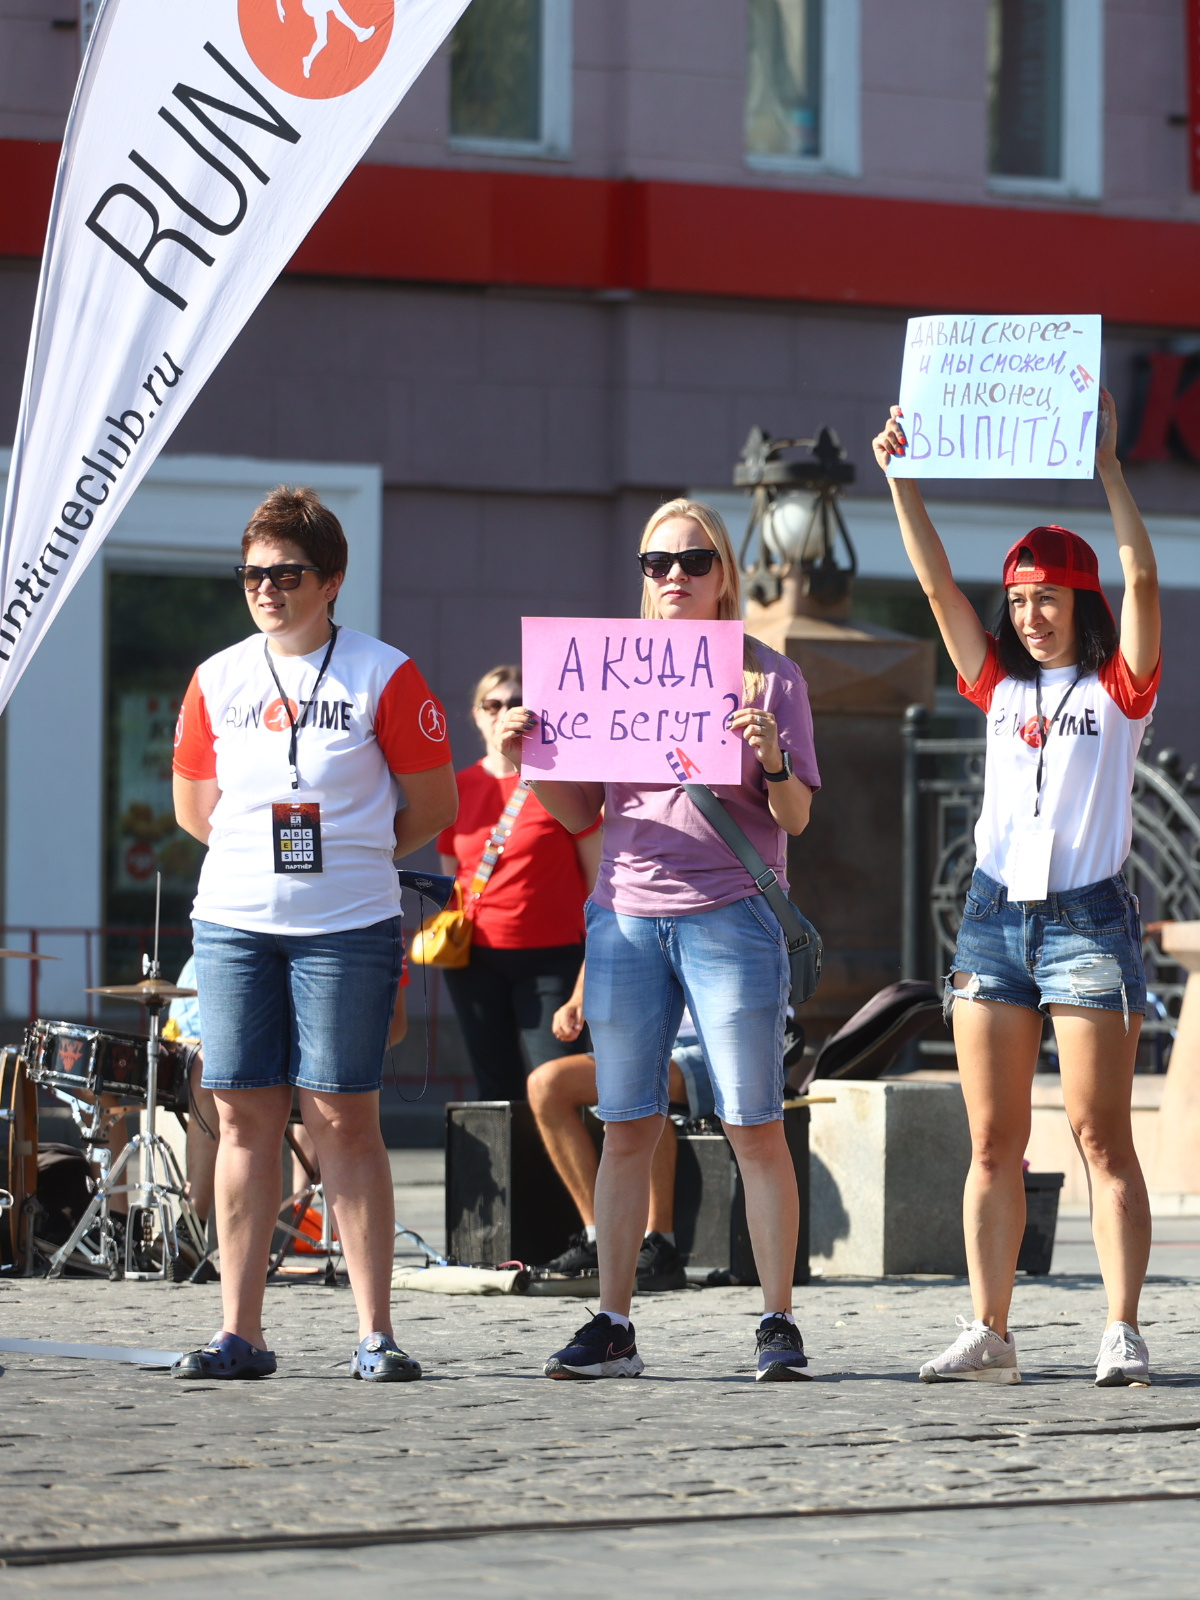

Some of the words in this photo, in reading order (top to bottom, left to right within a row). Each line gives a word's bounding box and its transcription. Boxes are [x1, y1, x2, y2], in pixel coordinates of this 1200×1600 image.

[84, 41, 301, 312] RUN
[910, 317, 976, 349] ДАВАЙ
[940, 352, 973, 375] МЫ
[557, 636, 585, 692] А
[601, 635, 714, 692] КУДА
[299, 699, 354, 731] TIME
